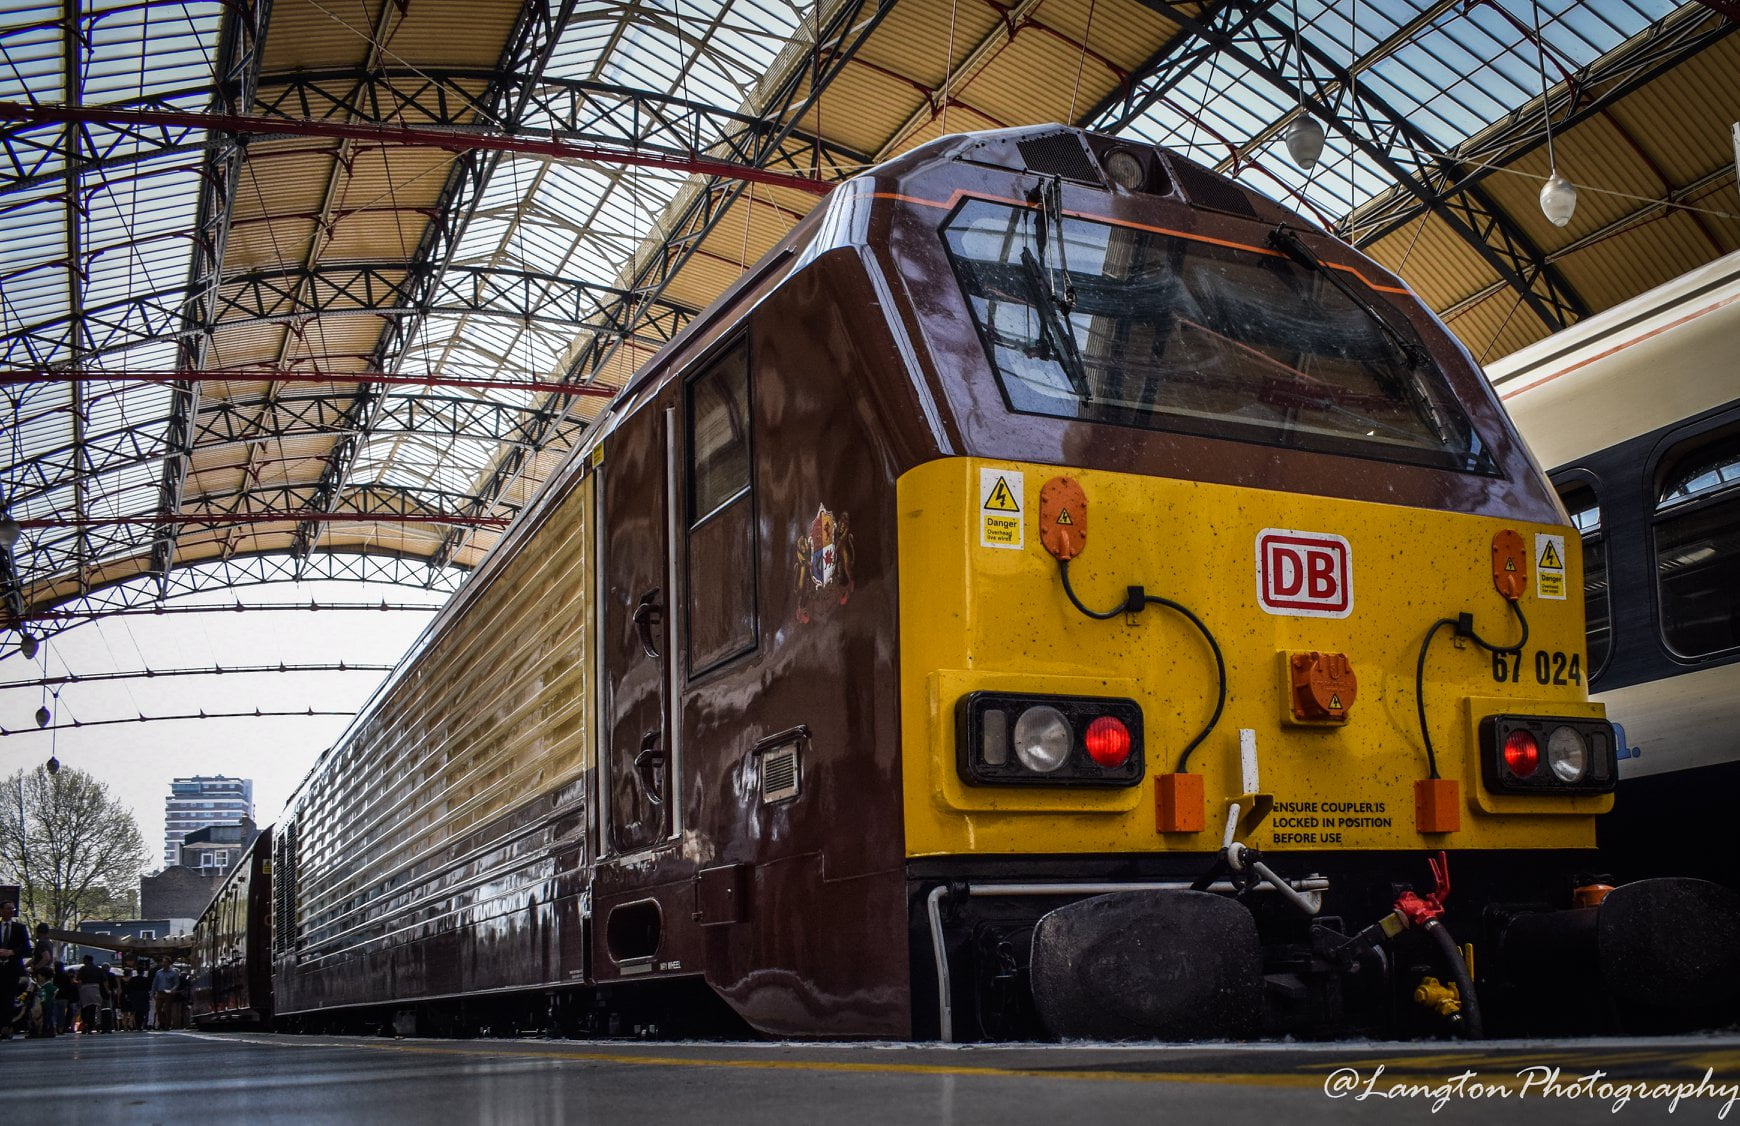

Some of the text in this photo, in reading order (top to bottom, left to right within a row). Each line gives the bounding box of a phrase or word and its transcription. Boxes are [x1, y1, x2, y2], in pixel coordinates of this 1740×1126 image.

[987, 517, 1017, 529] Danger
[1272, 547, 1337, 599] DB
[1541, 574, 1562, 583] Danger
[1492, 649, 1581, 687] 67 024
[1272, 802, 1386, 813] ENSURE COUPLER IS
[1272, 817, 1392, 828] LOCKED IN POSITION
[1273, 833, 1342, 844] BEFORE USE
